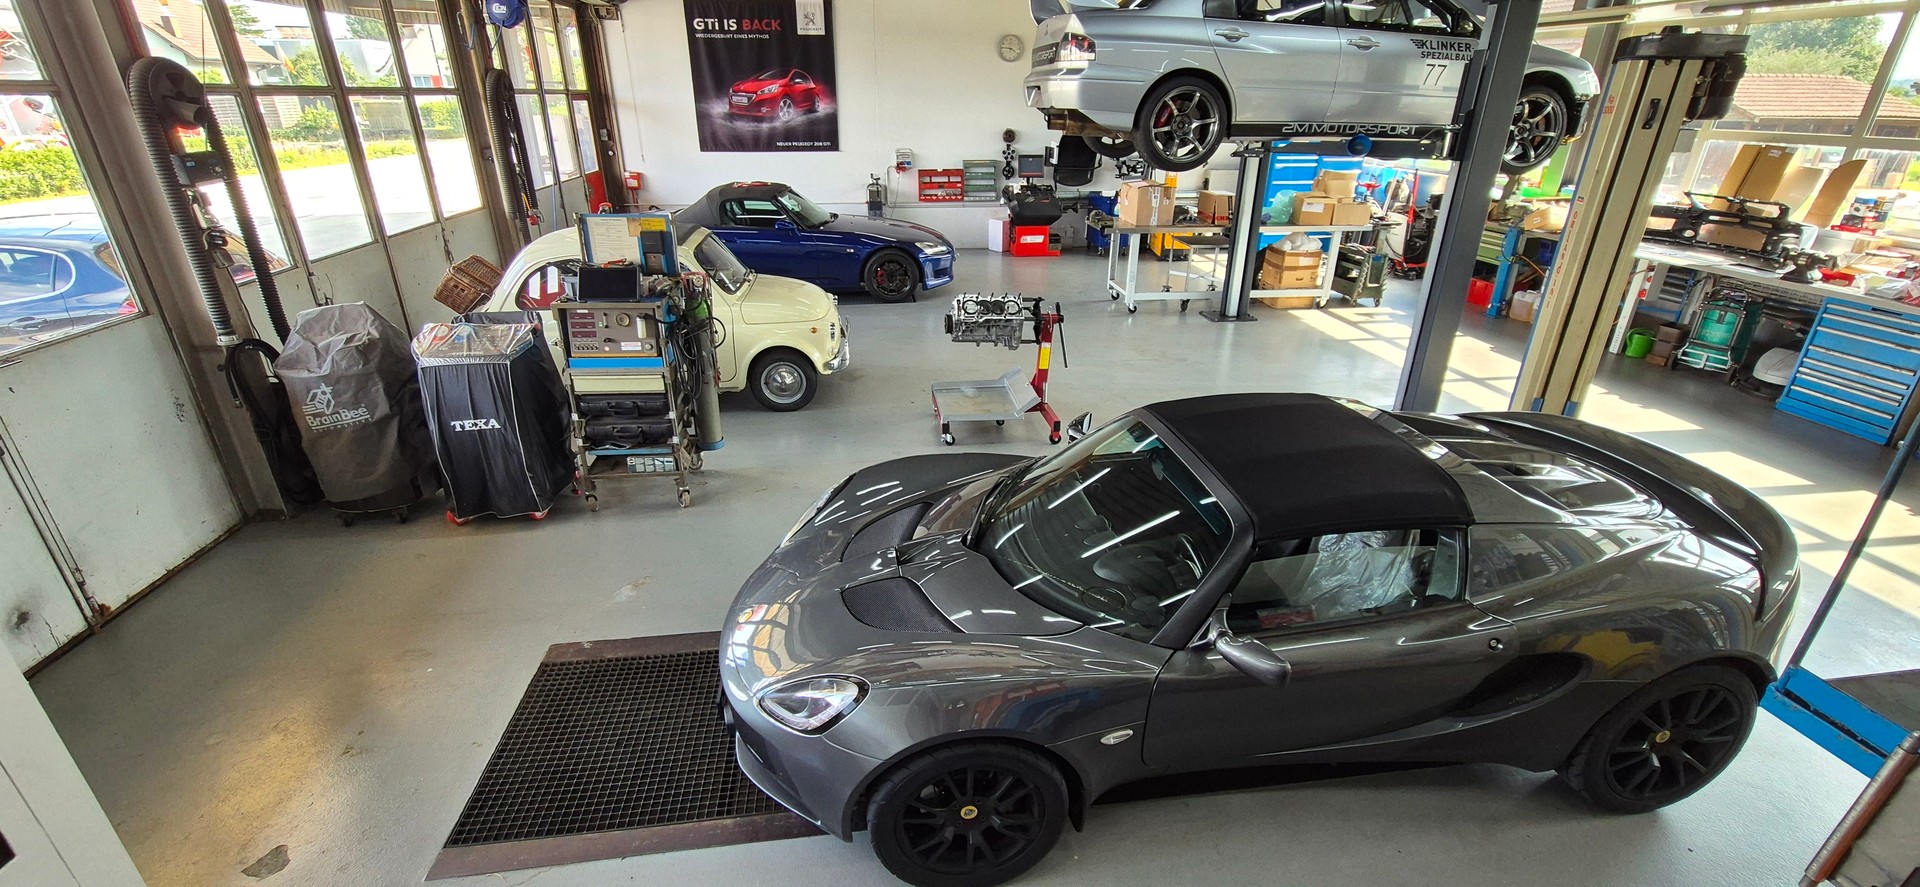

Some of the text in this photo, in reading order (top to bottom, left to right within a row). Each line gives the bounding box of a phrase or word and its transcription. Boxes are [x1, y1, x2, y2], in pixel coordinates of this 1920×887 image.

[693, 18, 781, 31] GTi IS BACK
[1423, 64, 1447, 86] 77
[1282, 122, 1420, 135] 2M MOTORSPORT
[305, 407, 369, 427] BrainBee
[451, 418, 501, 432] TEXA
